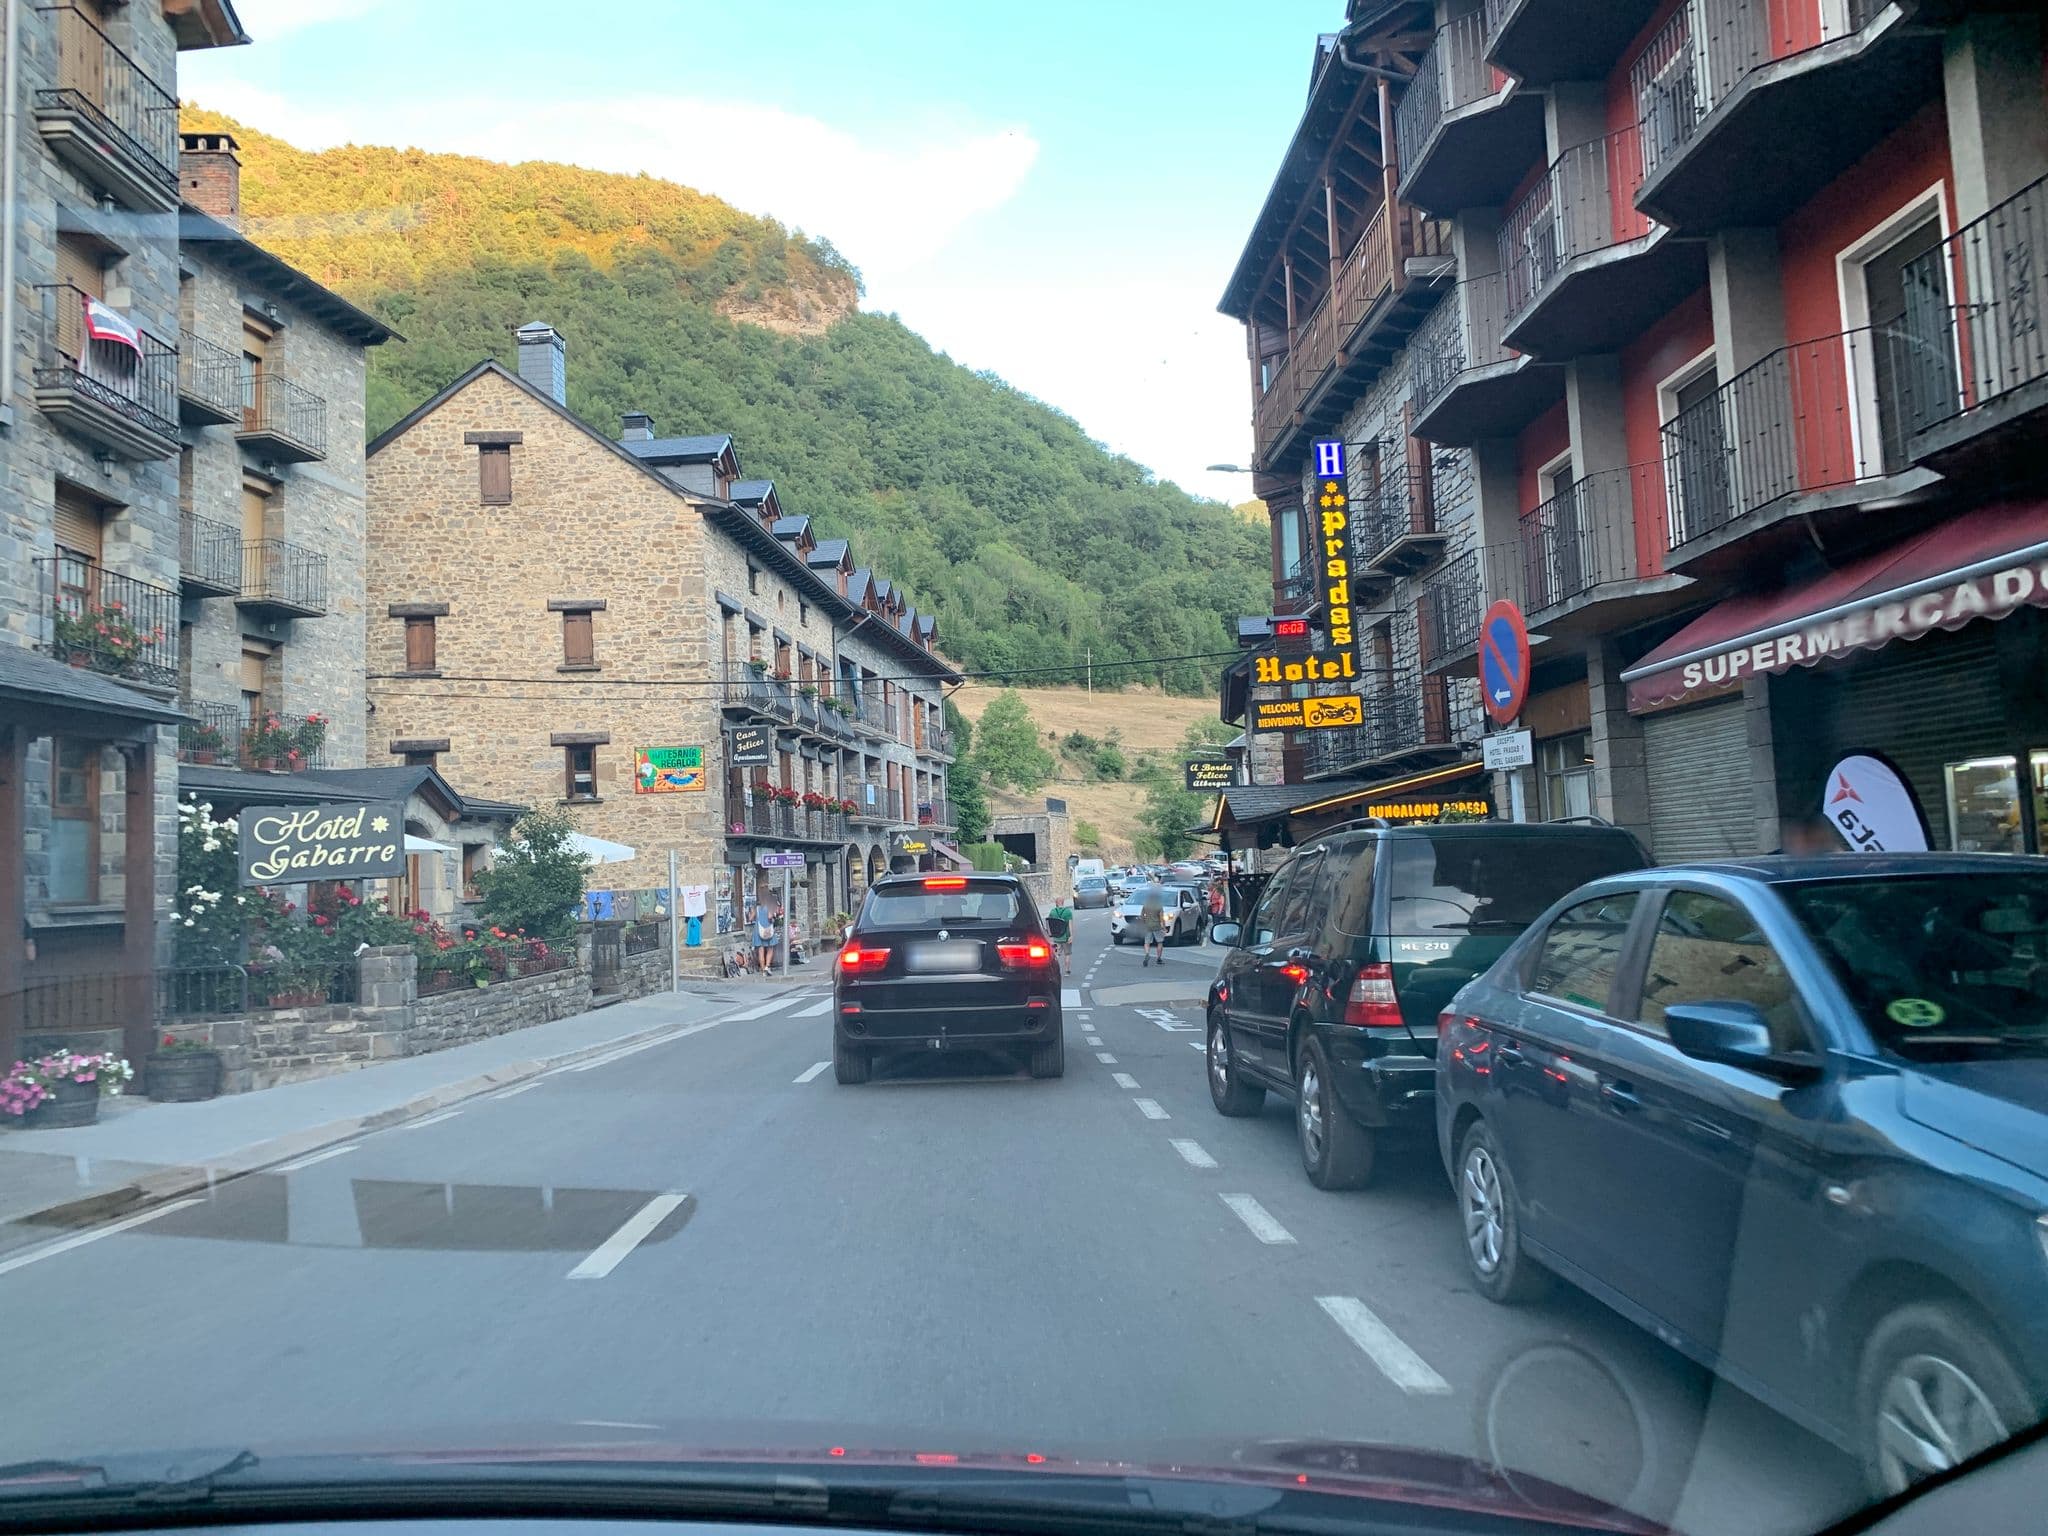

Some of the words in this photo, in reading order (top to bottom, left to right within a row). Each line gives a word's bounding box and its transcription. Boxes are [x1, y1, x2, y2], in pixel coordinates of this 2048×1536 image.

[1683, 563, 2048, 688] SUPERMERCAD
[1256, 653, 1355, 683] Hotel
[1259, 702, 1300, 714] WELCOME
[1258, 716, 1304, 728] BIENVENIDOS
[736, 731, 757, 741] Casa
[736, 739, 765, 753] Felices
[661, 757, 697, 769] REGALOS
[1202, 763, 1233, 771] Borda
[1368, 802, 1440, 818] BUNGALOWS
[254, 807, 366, 844] Hotel
[250, 844, 396, 880] Gabarre
[1424, 942, 1450, 951] 270
